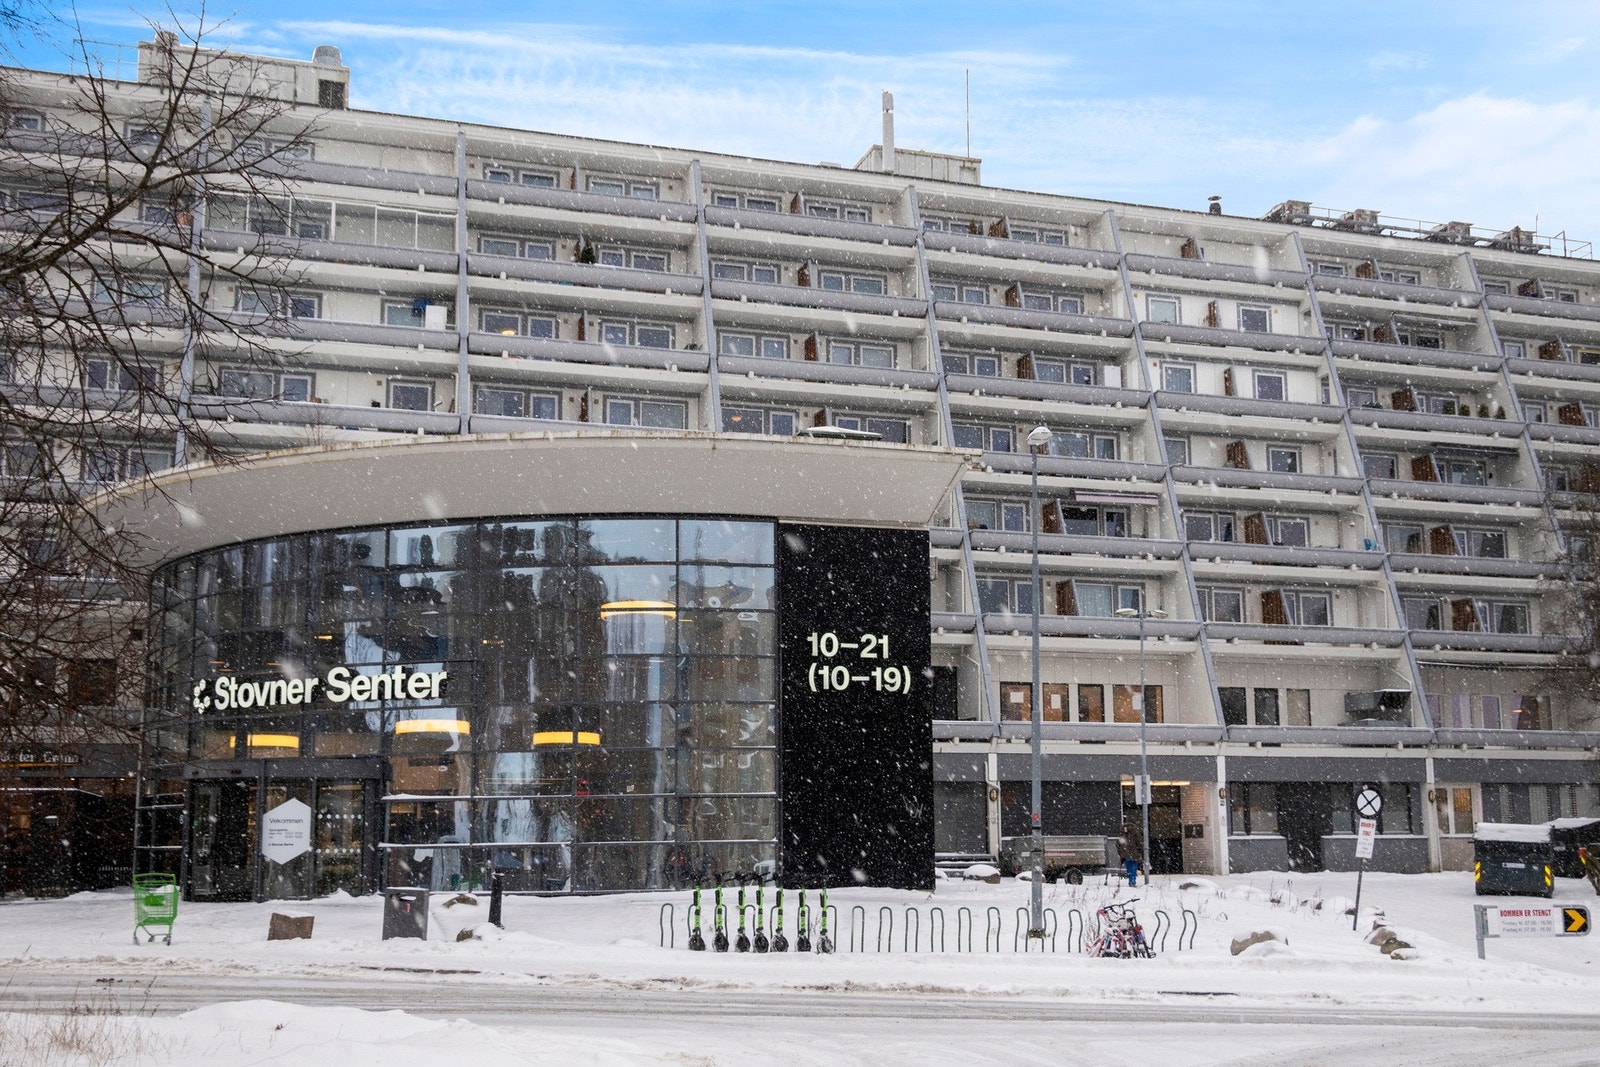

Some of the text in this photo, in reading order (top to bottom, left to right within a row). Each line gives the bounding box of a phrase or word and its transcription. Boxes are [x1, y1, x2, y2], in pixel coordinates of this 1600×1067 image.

[214, 666, 448, 710] Stovner Senter
[1500, 909, 1552, 917] BOMMEN ER STENGT
